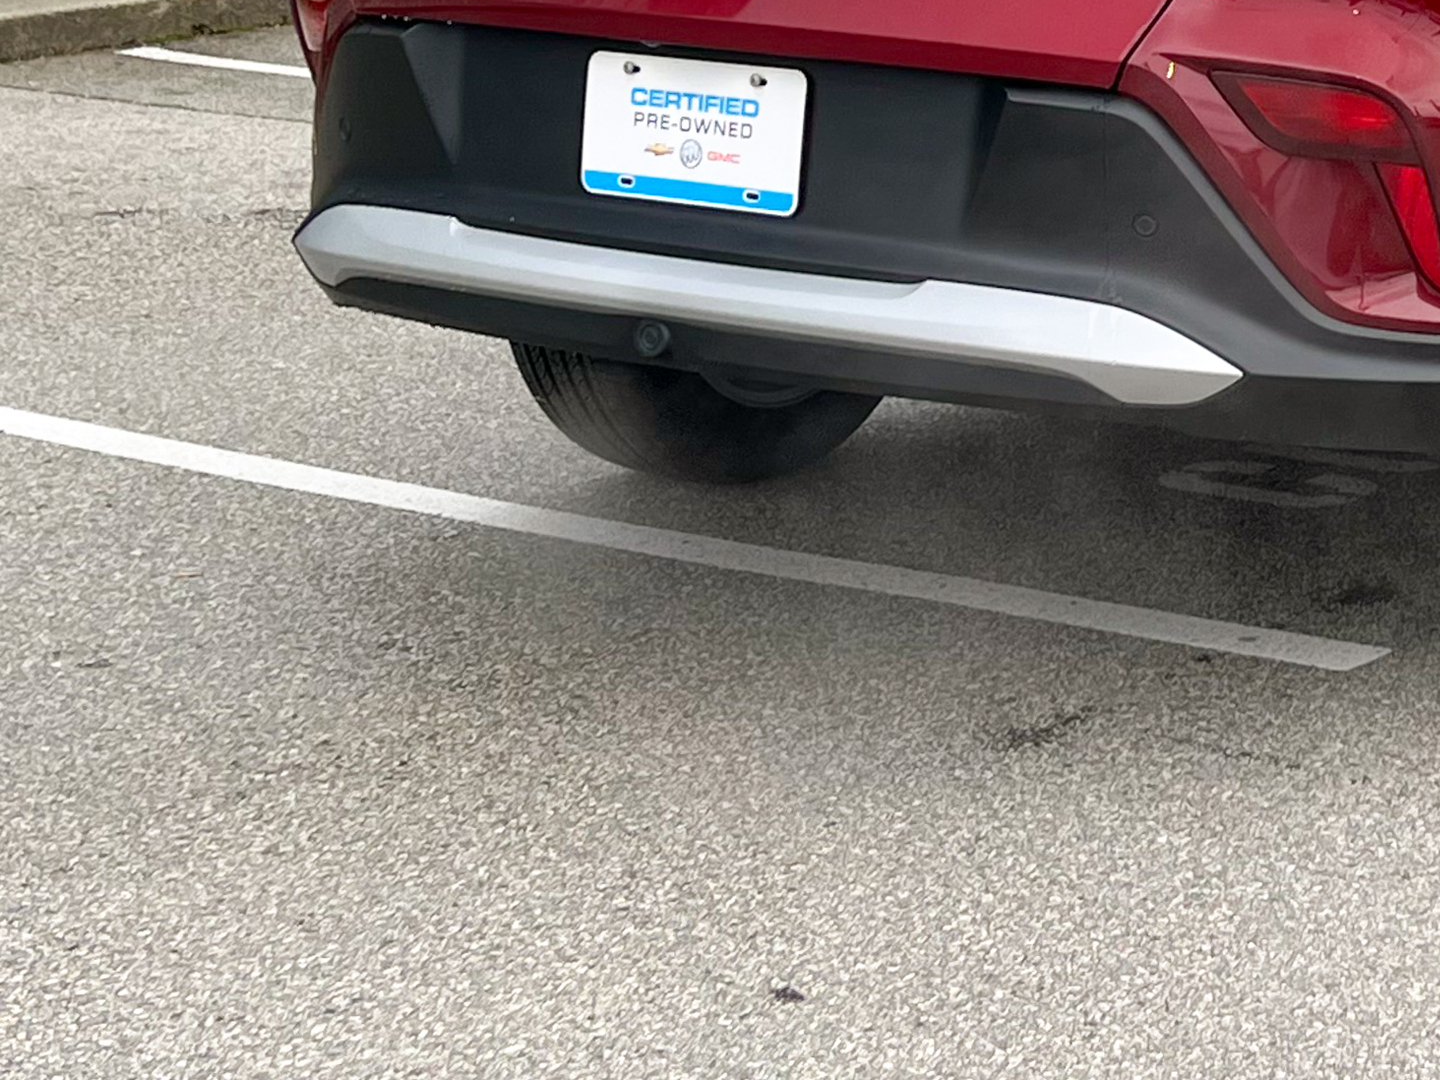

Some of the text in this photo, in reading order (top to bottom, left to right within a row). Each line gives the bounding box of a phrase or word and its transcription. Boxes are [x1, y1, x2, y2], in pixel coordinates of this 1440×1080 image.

[630, 87, 760, 118] CERTIFIED
[633, 111, 753, 139] PRE-OWNED
[707, 150, 741, 164] GMC
